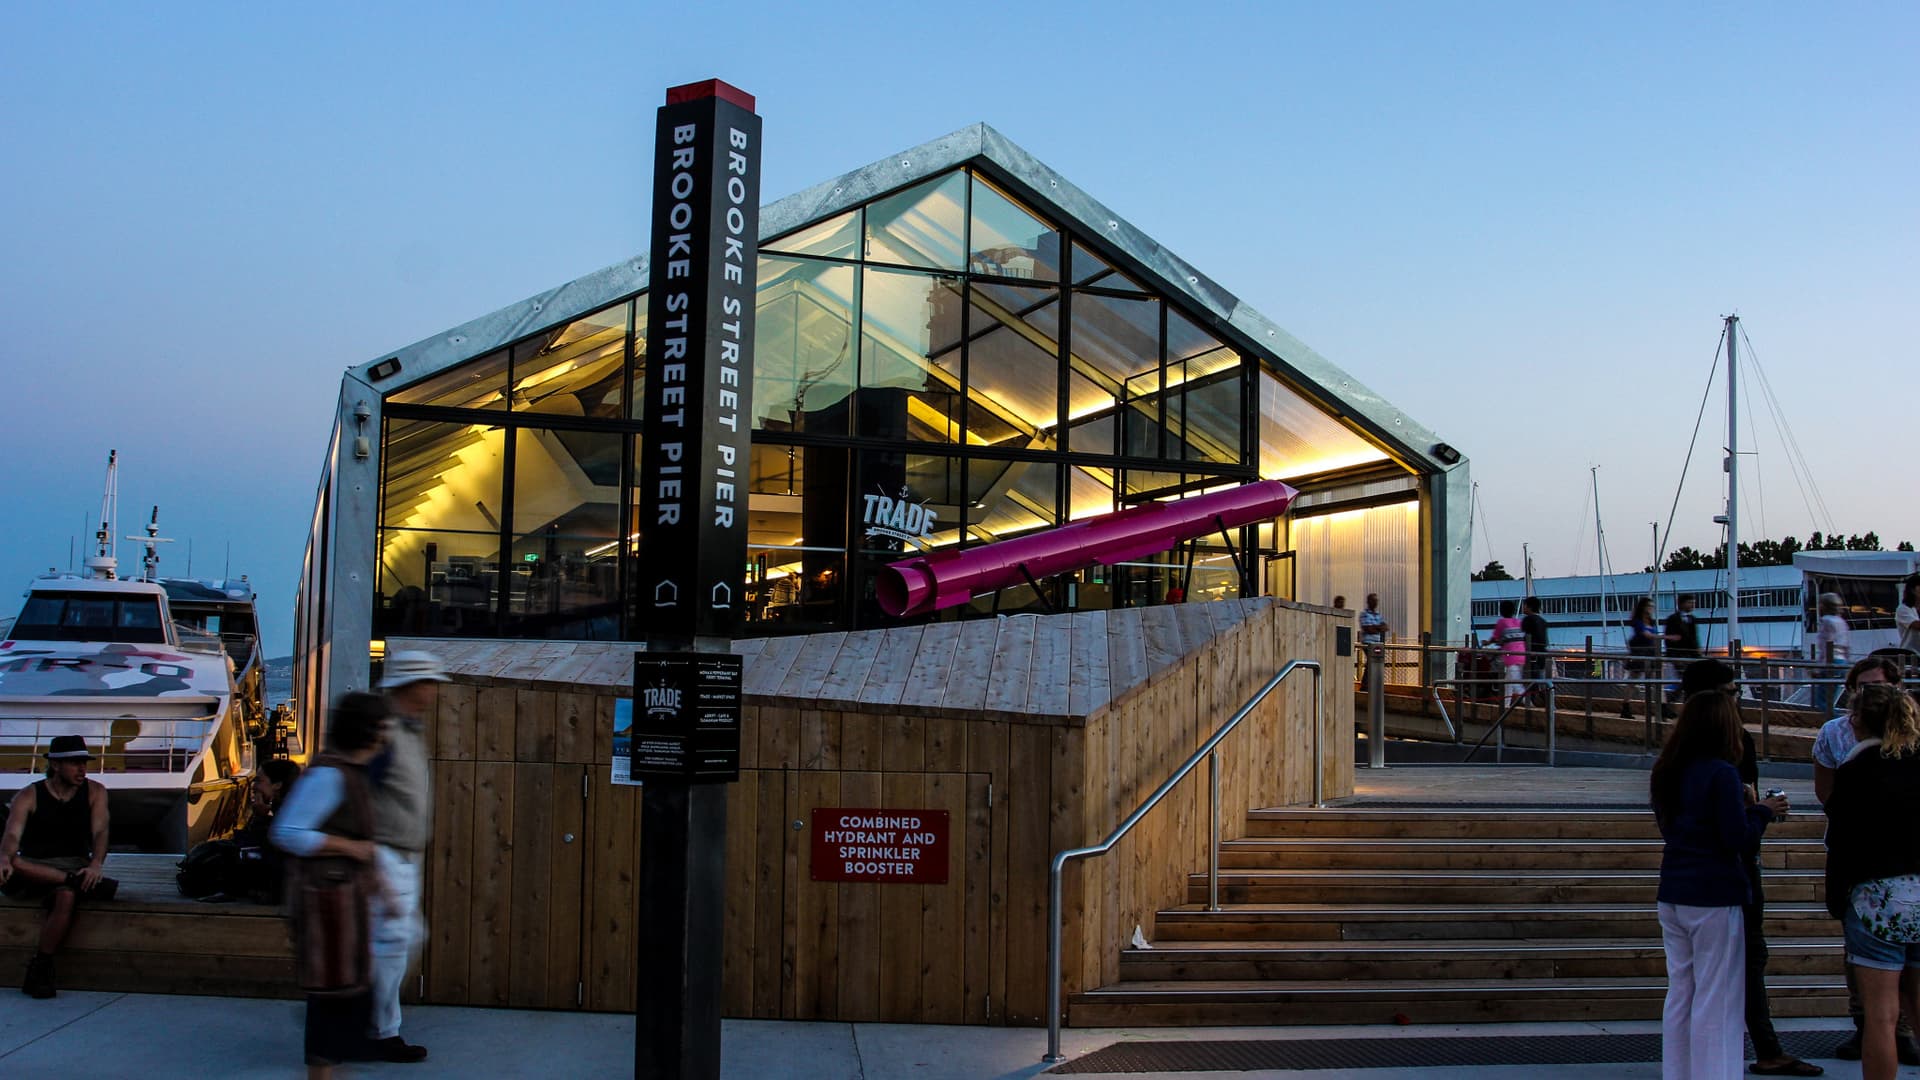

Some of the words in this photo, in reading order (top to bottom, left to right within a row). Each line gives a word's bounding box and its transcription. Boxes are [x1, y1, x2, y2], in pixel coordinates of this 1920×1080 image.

[667, 123, 696, 280] BROOKE
[724, 127, 747, 285] BROOKE
[661, 291, 688, 427] STREET
[718, 295, 741, 433] STREET
[658, 441, 683, 525] PIER
[714, 444, 736, 529] PIER
[863, 494, 938, 540] TRADE
[643, 688, 682, 709] TRADE
[824, 831, 896, 844] HYDRANT
[902, 833, 935, 845] AND
[840, 816, 921, 829] COMBINED
[840, 847, 920, 860] SPRINKLER
[845, 862, 914, 875] BOOSTER
